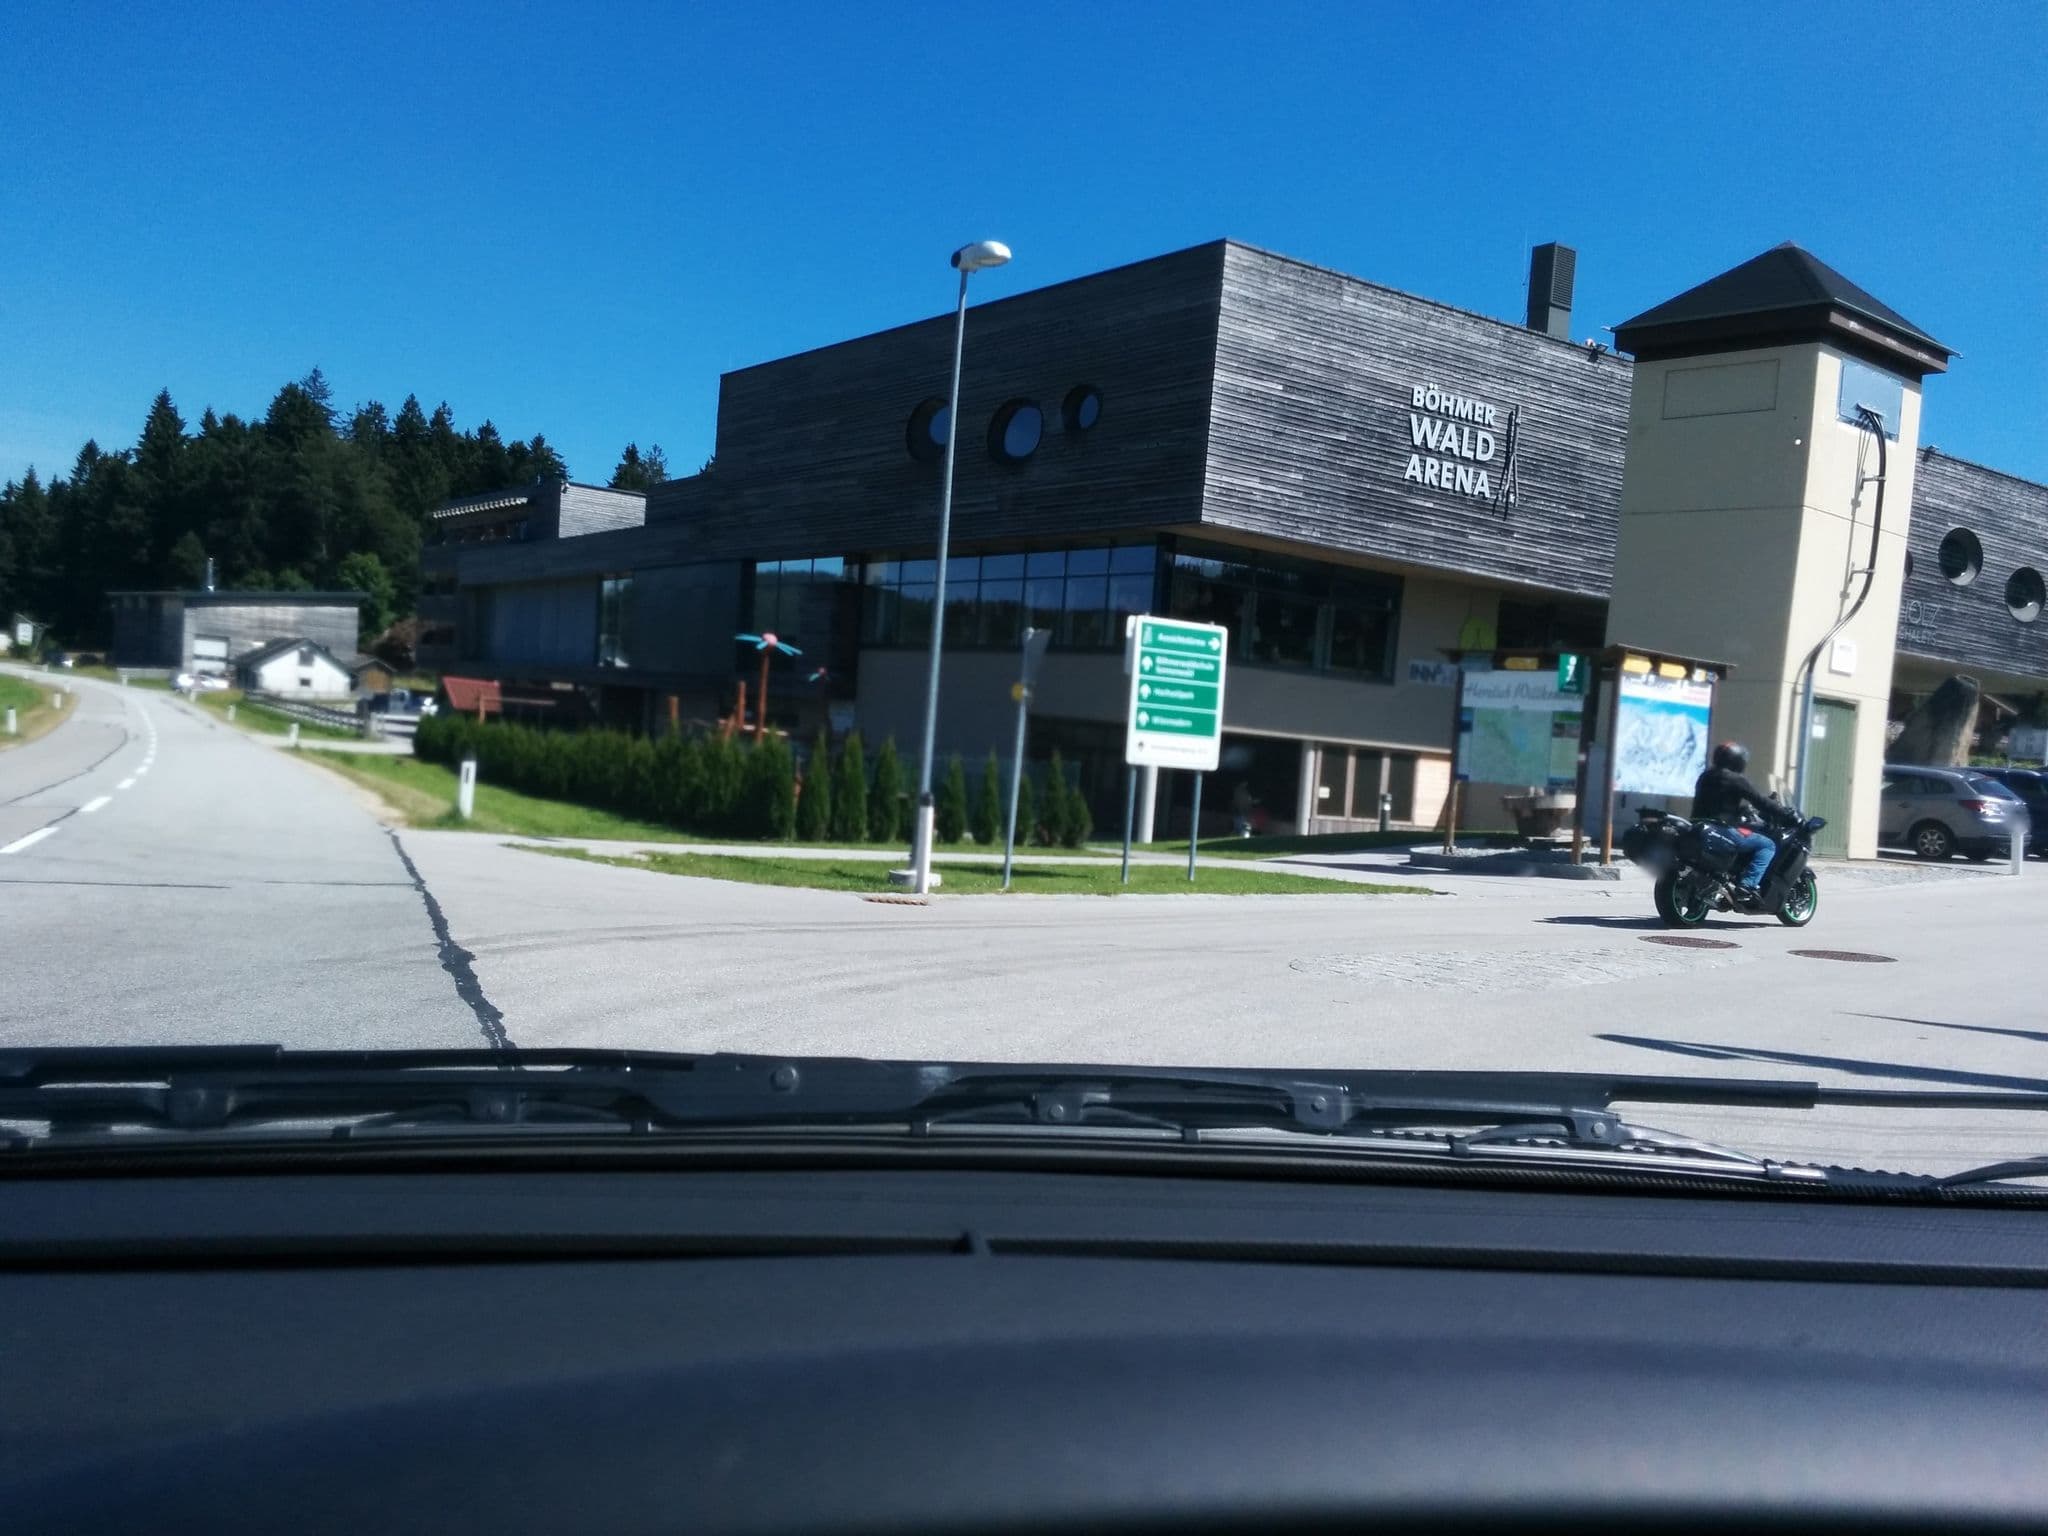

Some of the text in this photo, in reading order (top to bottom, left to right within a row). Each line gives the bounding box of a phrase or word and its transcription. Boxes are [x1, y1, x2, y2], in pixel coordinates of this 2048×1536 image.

[1412, 383, 1497, 426] BÖHMER
[1410, 413, 1496, 462] WALD
[1404, 454, 1490, 498] ARENA
